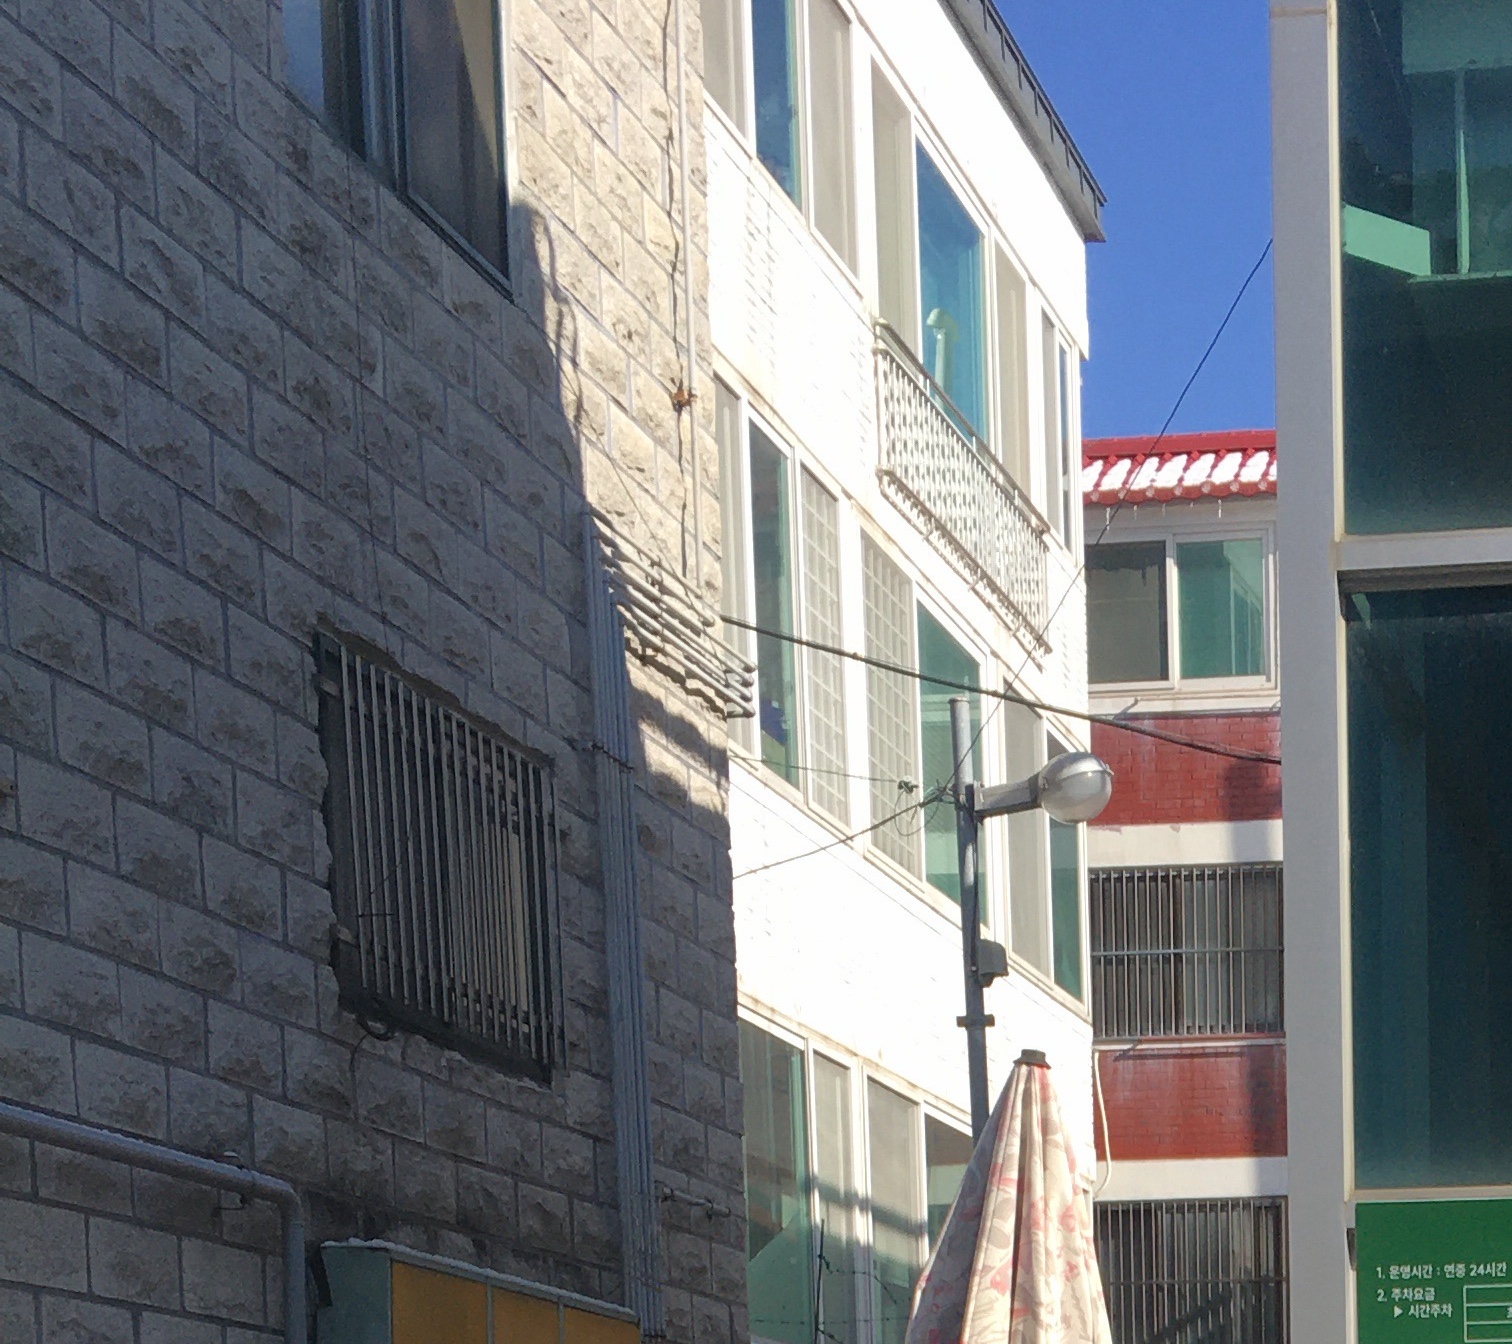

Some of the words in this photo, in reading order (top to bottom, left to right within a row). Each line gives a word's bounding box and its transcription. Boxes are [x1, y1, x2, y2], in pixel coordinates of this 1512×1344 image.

[1376, 1267, 1385, 1278] 1.
[1389, 1265, 1433, 1280] 운영시간
[1444, 1264, 1466, 1279] 연중
[1470, 1262, 1507, 1278] 24시간
[1377, 1290, 1387, 1302] 2.
[1391, 1287, 1436, 1302] 주차요금
[1408, 1303, 1453, 1319] 시간주차
